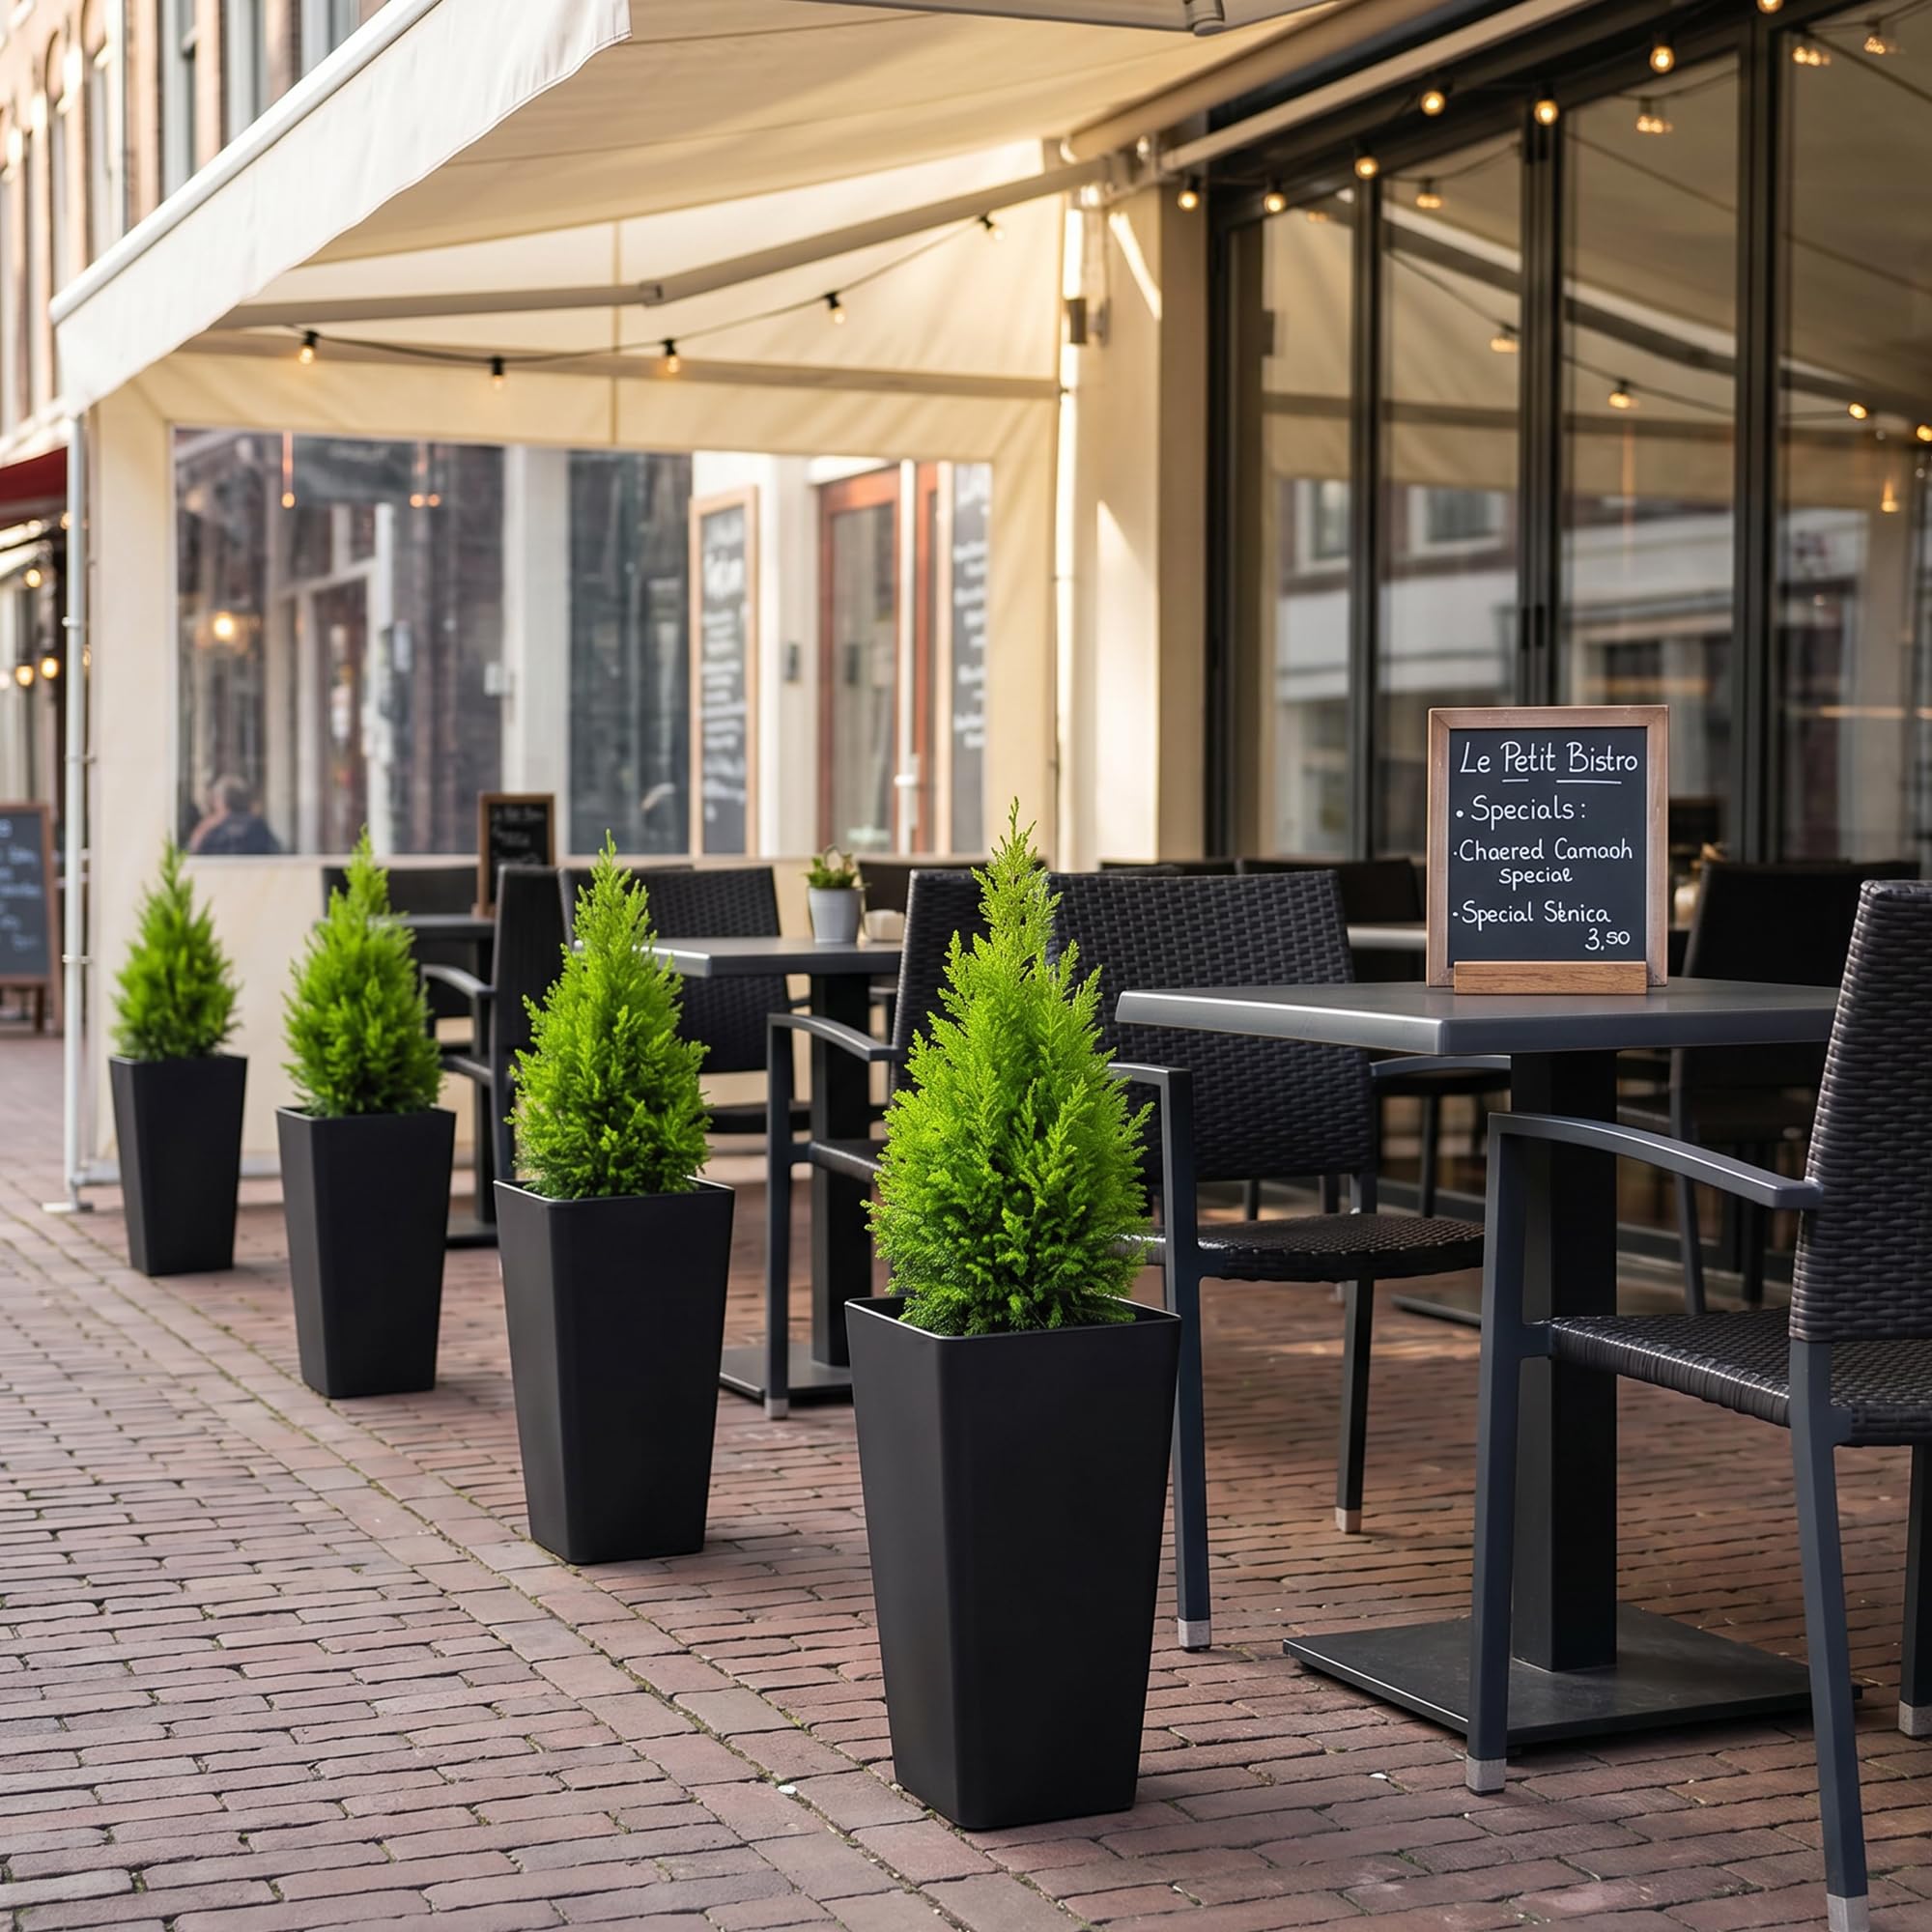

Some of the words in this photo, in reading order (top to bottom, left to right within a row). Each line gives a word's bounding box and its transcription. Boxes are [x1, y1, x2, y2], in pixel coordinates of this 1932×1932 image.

[1459, 740, 1492, 774] Le
[1499, 740, 1557, 773] Petit
[1565, 741, 1639, 773] Bistro
[1462, 899, 1534, 932] Special
